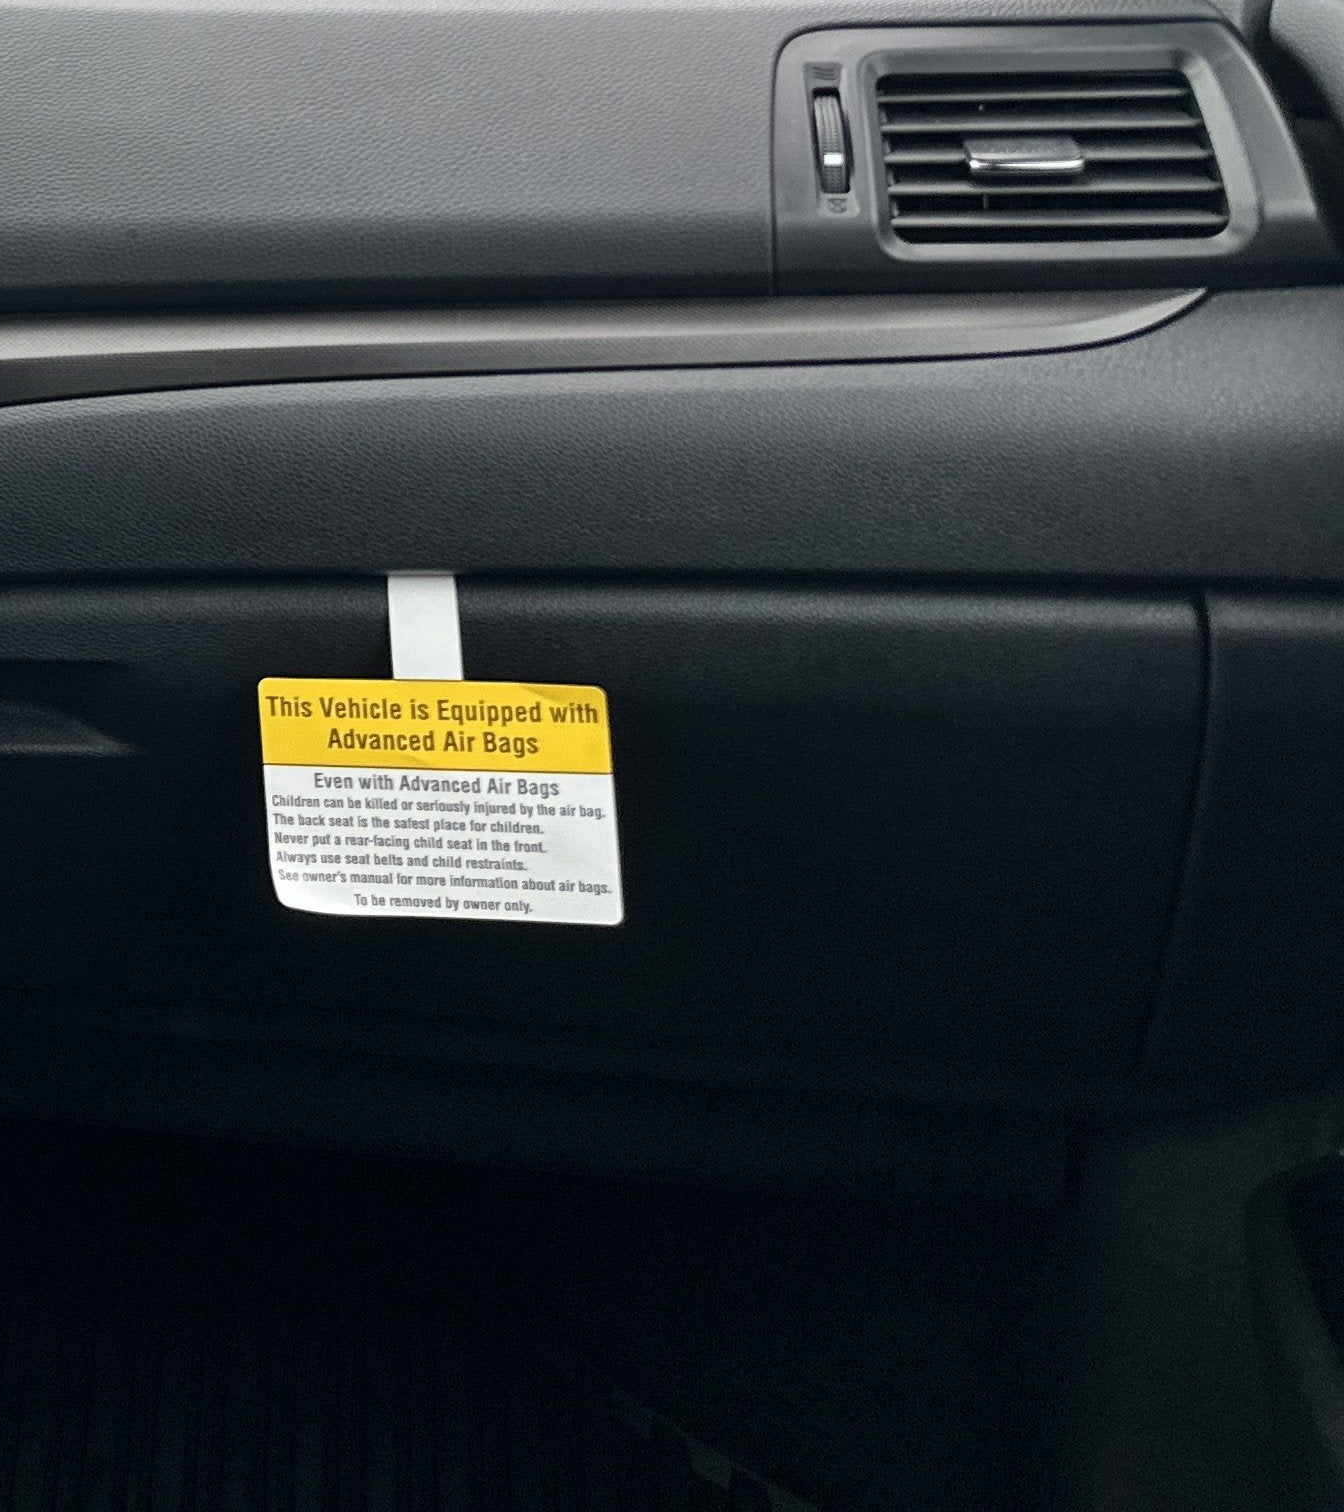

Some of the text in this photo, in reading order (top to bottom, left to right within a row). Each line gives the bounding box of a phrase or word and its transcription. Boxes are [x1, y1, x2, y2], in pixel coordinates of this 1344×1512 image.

[265, 695, 600, 727] This Vehicle is Equipped with
[327, 727, 539, 759] Advanced Air Bags
[313, 772, 560, 800] Even with Advanced Air Bags
[272, 794, 606, 820] Children can be killed or seriously injured by the air bag.
[273, 813, 545, 835] The back seat is the safest place for children.
[274, 832, 548, 854] Never put a rear-facing child seat in the front.
[276, 850, 529, 872] Always use seat belts and child restraints.
[278, 869, 613, 896] See owner's manual for more information about air bags.
[353, 893, 534, 915] To be removed by owner only.
